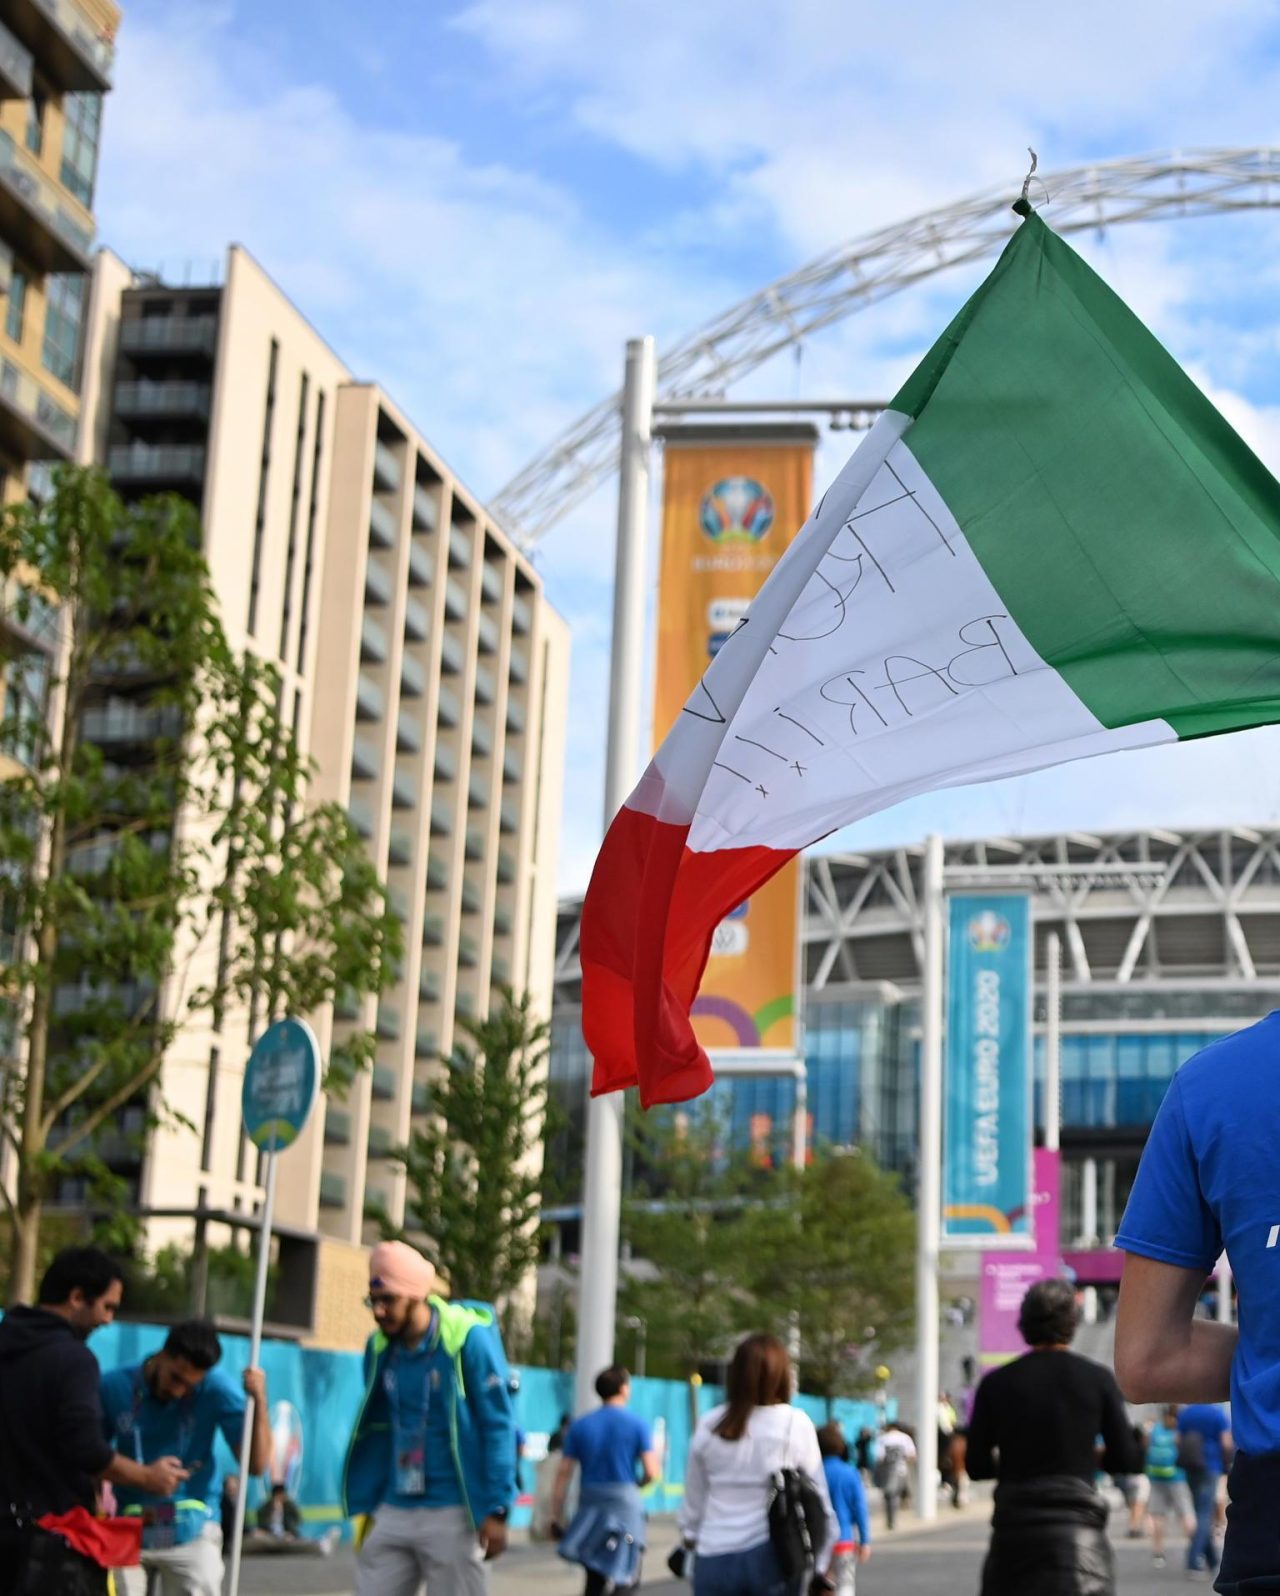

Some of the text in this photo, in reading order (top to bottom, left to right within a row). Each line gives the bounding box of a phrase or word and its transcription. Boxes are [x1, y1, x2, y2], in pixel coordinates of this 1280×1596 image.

[974, 969, 1000, 1187] UEFA EURO 2020
